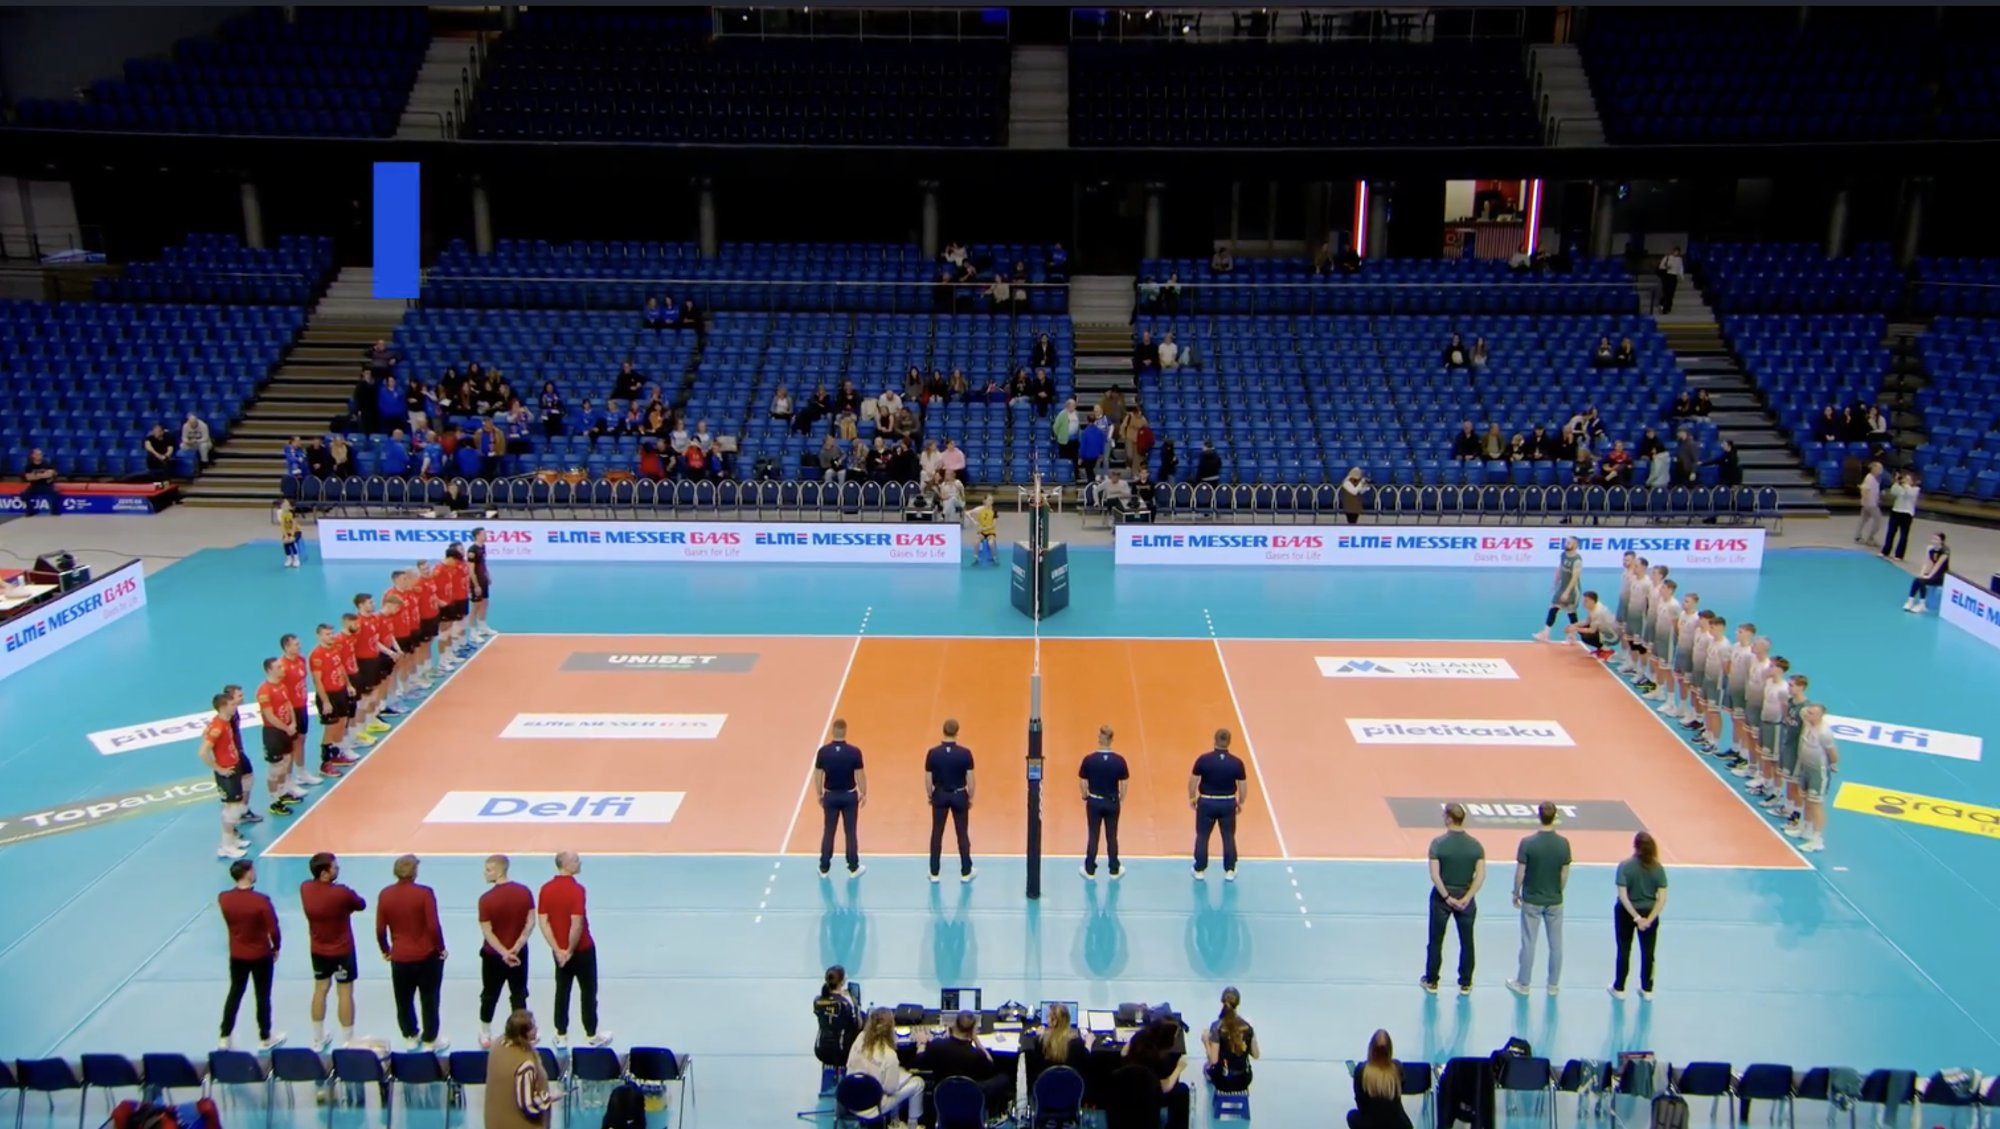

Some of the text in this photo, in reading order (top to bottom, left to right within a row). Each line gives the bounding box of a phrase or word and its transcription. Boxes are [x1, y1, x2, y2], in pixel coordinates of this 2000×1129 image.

[336, 529, 532, 543] ELME MESSER GAAS
[547, 531, 741, 544] ELME MESSER GAAS
[755, 532, 946, 546] ELME MESSER GAAS
[1131, 535, 1323, 548] ELME MESSER GAAS
[1338, 536, 1534, 550] ELME MESSER GAAS
[1608, 538, 1690, 550] MESSER
[1695, 538, 1747, 551] GAAS
[1951, 588, 1984, 617] ELME
[6, 620, 46, 653] ELME
[48, 592, 103, 631] MESSER
[104, 576, 136, 603] GAAS
[607, 655, 717, 664] UNIBET
[1362, 724, 1556, 738] piletitasku
[1829, 724, 1929, 747] elfi
[21, 781, 217, 827] Topauto
[477, 797, 635, 816] Delfi
